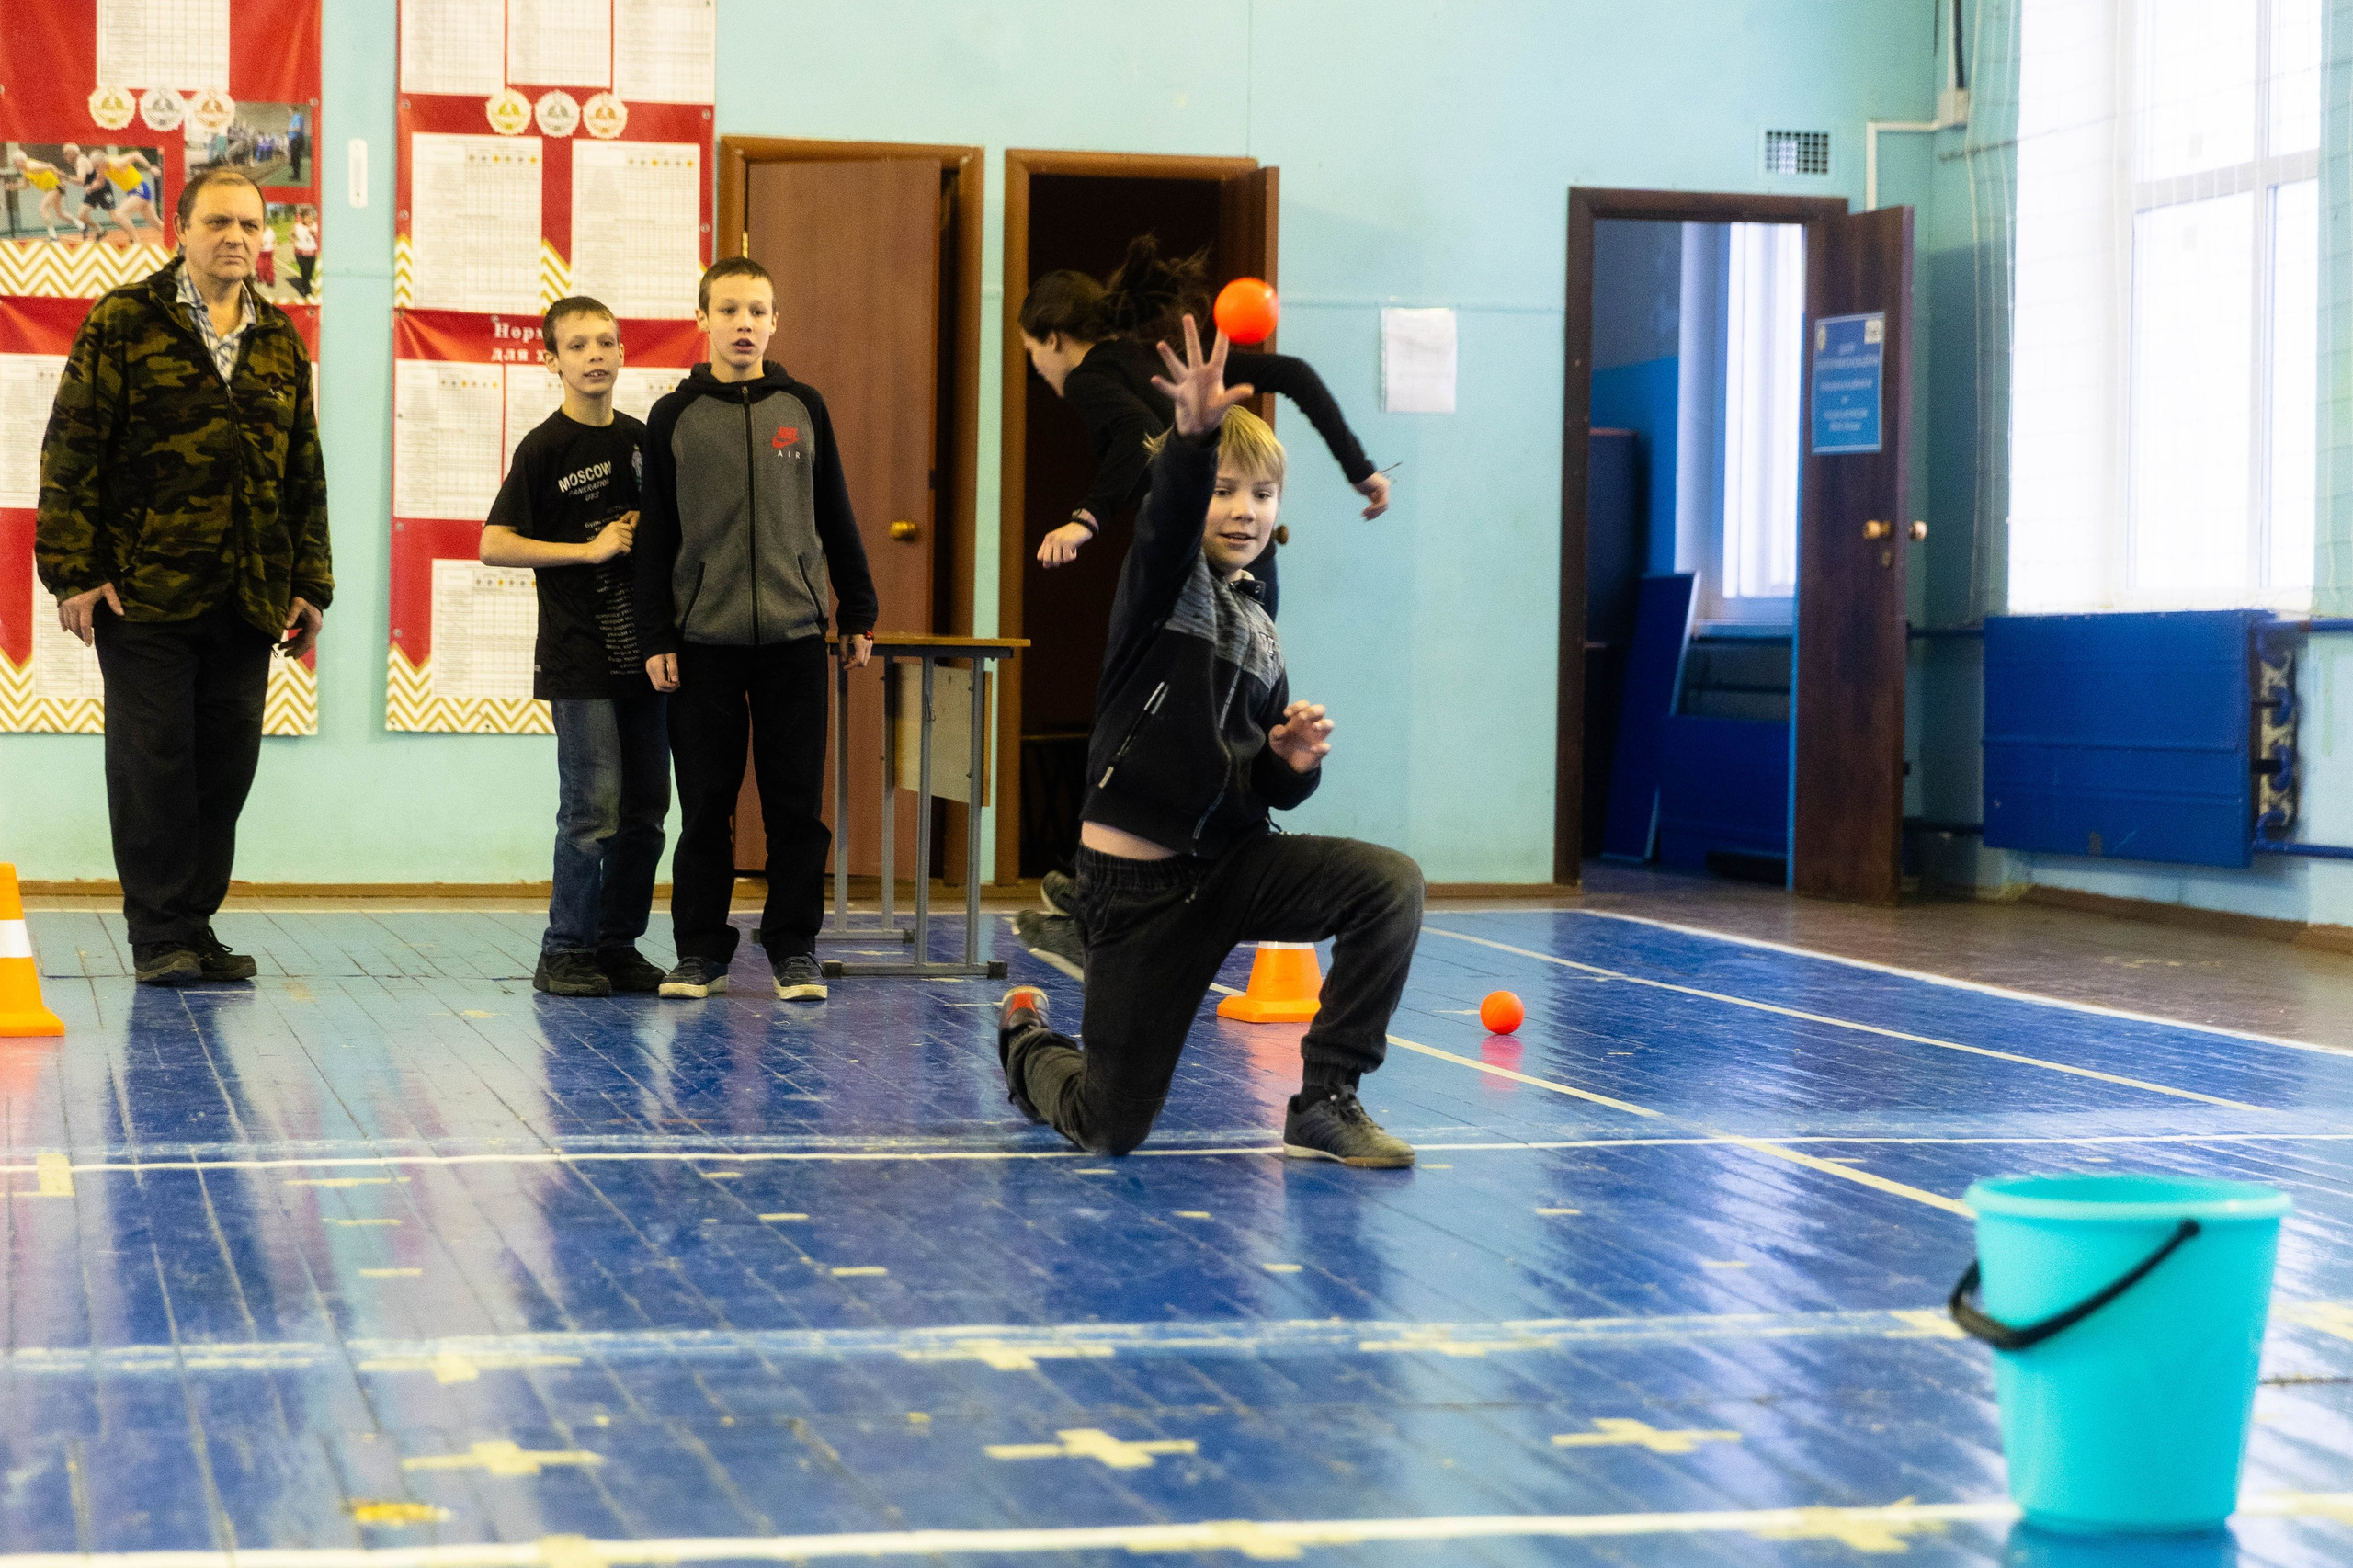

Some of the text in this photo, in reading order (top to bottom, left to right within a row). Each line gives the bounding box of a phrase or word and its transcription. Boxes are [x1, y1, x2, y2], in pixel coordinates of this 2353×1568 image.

[491, 348, 529, 363] для
[778, 449, 801, 460] AIR
[557, 460, 612, 494] MOSCOW
